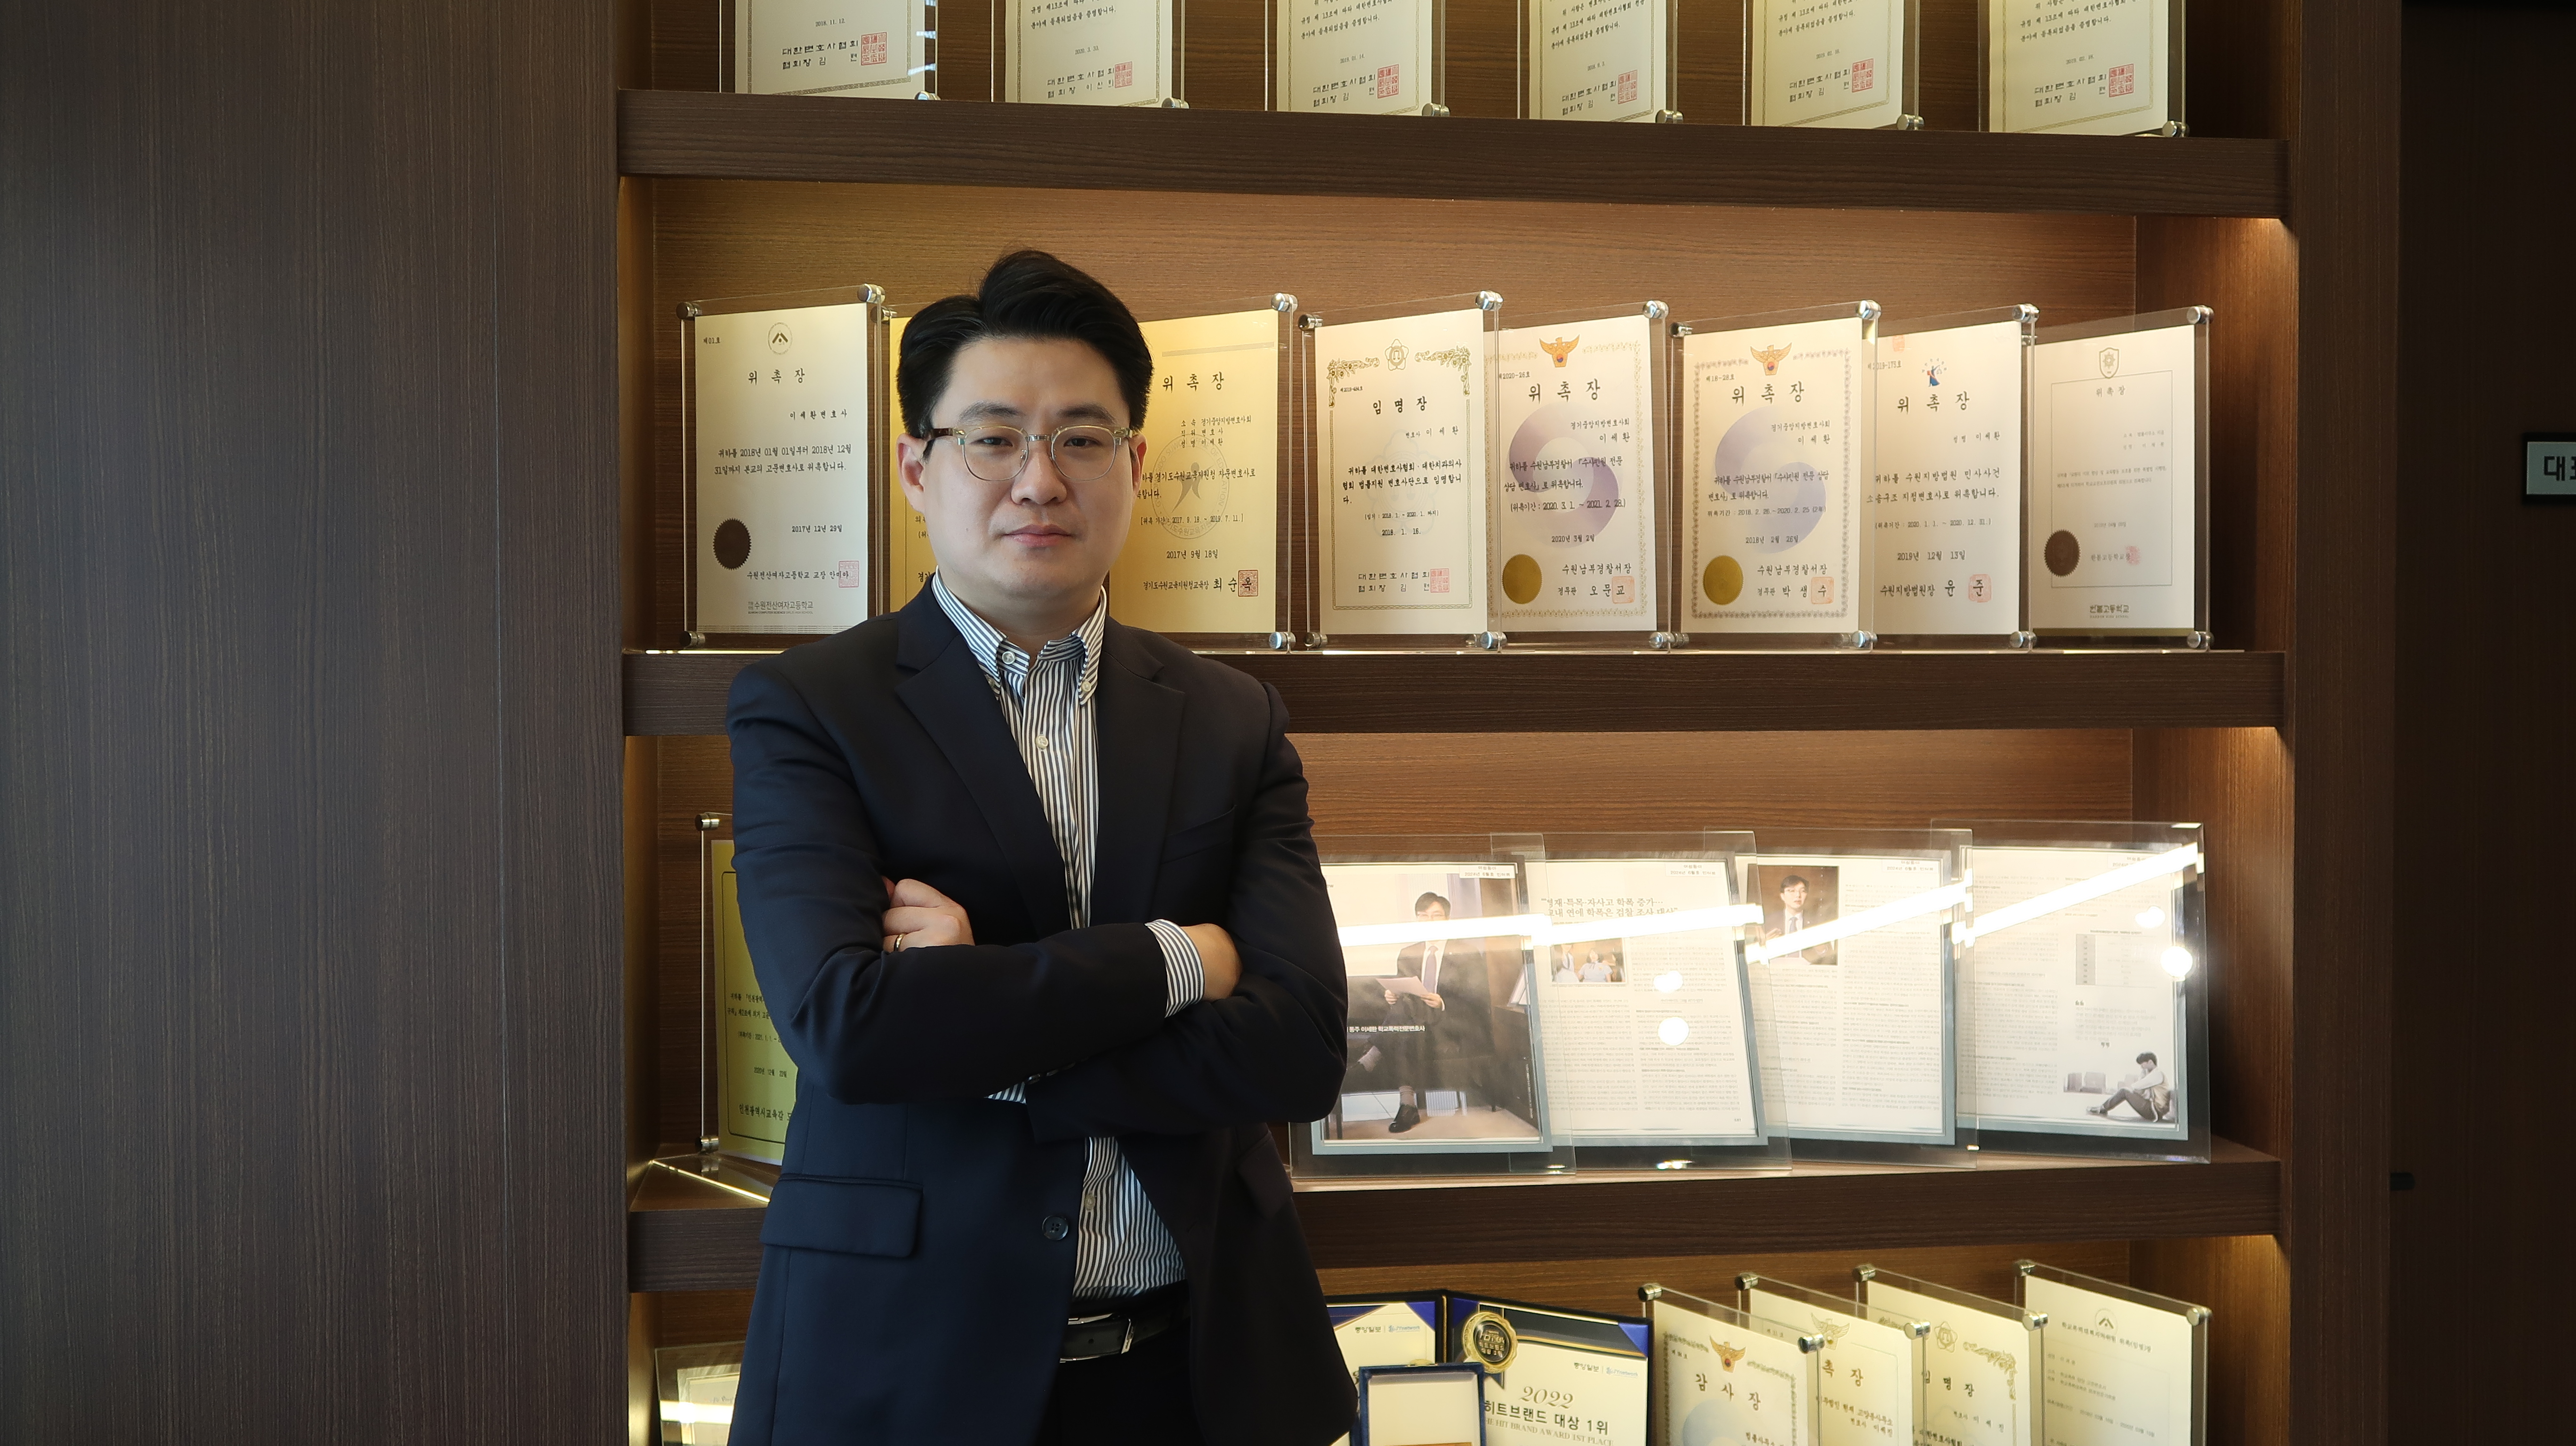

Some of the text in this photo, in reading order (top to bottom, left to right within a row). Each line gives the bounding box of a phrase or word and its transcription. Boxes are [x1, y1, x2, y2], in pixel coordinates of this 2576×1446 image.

[782, 40, 859, 56] 대한변호사협회
[782, 58, 811, 70] 협회장
[1570, 418, 1630, 430] 경기중앙지방변호사회
[1770, 420, 1831, 433] 경기중앙지방변호사회
[718, 443, 851, 458] 귀하를 2018년 01월 01일부터 2018년 12월
[744, 464, 762, 474] 본교의
[766, 463, 805, 473] 고문변호사로
[807, 461, 846, 472] 위촉합니다.
[1348, 466, 1367, 476] 귀하를
[1371, 462, 1415, 474] 대한변호사협회
[1530, 458, 1573, 470] 수원남부경찰서
[1610, 456, 1623, 467] 전문
[1155, 467, 1256, 482] 경기도수원교육지원청 자문변호사로
[1733, 472, 1772, 485] 수원남부경찰서
[1802, 471, 1814, 482] 전문
[1818, 470, 1829, 481] 상담
[1875, 466, 2000, 484] 귀하를 수원지방법원 민사사건
[1343, 474, 1461, 490] 협회 법률지원 변호사단으로 임명합니
[1504, 482, 1515, 492] 상담
[1551, 478, 1584, 490] 위촉합니다.
[1739, 489, 1769, 500] 위촉합니다.
[1866, 487, 2000, 504] 소송구조 지정변호사로 위촉합니다.
[792, 525, 811, 533] 2017년
[830, 524, 842, 532] 29일
[1552, 535, 1570, 543] 2020년
[1746, 536, 1765, 544] 2018년
[1167, 549, 1218, 559] 2017년 9월 18일
[1897, 549, 1965, 562] 2019년 12월 13일
[747, 570, 810, 580] 수원전산여자고등학교
[813, 570, 826, 579] 교장
[1358, 571, 1430, 580] 대한변호사협회
[1562, 563, 1632, 575] 수원남부경찰서장
[1757, 564, 1827, 576] 수원남부경찰서장
[1880, 583, 1936, 597] 수원지방법원장
[754, 601, 813, 610] 수원전산여자고등학교
[1519, 1385, 1574, 1409] 2022
[1484, 1400, 1609, 1436] 히트브랜드 대상 1위
[1510, 1422, 1538, 1435] BRAND
[1540, 1428, 1570, 1440] AWARD
